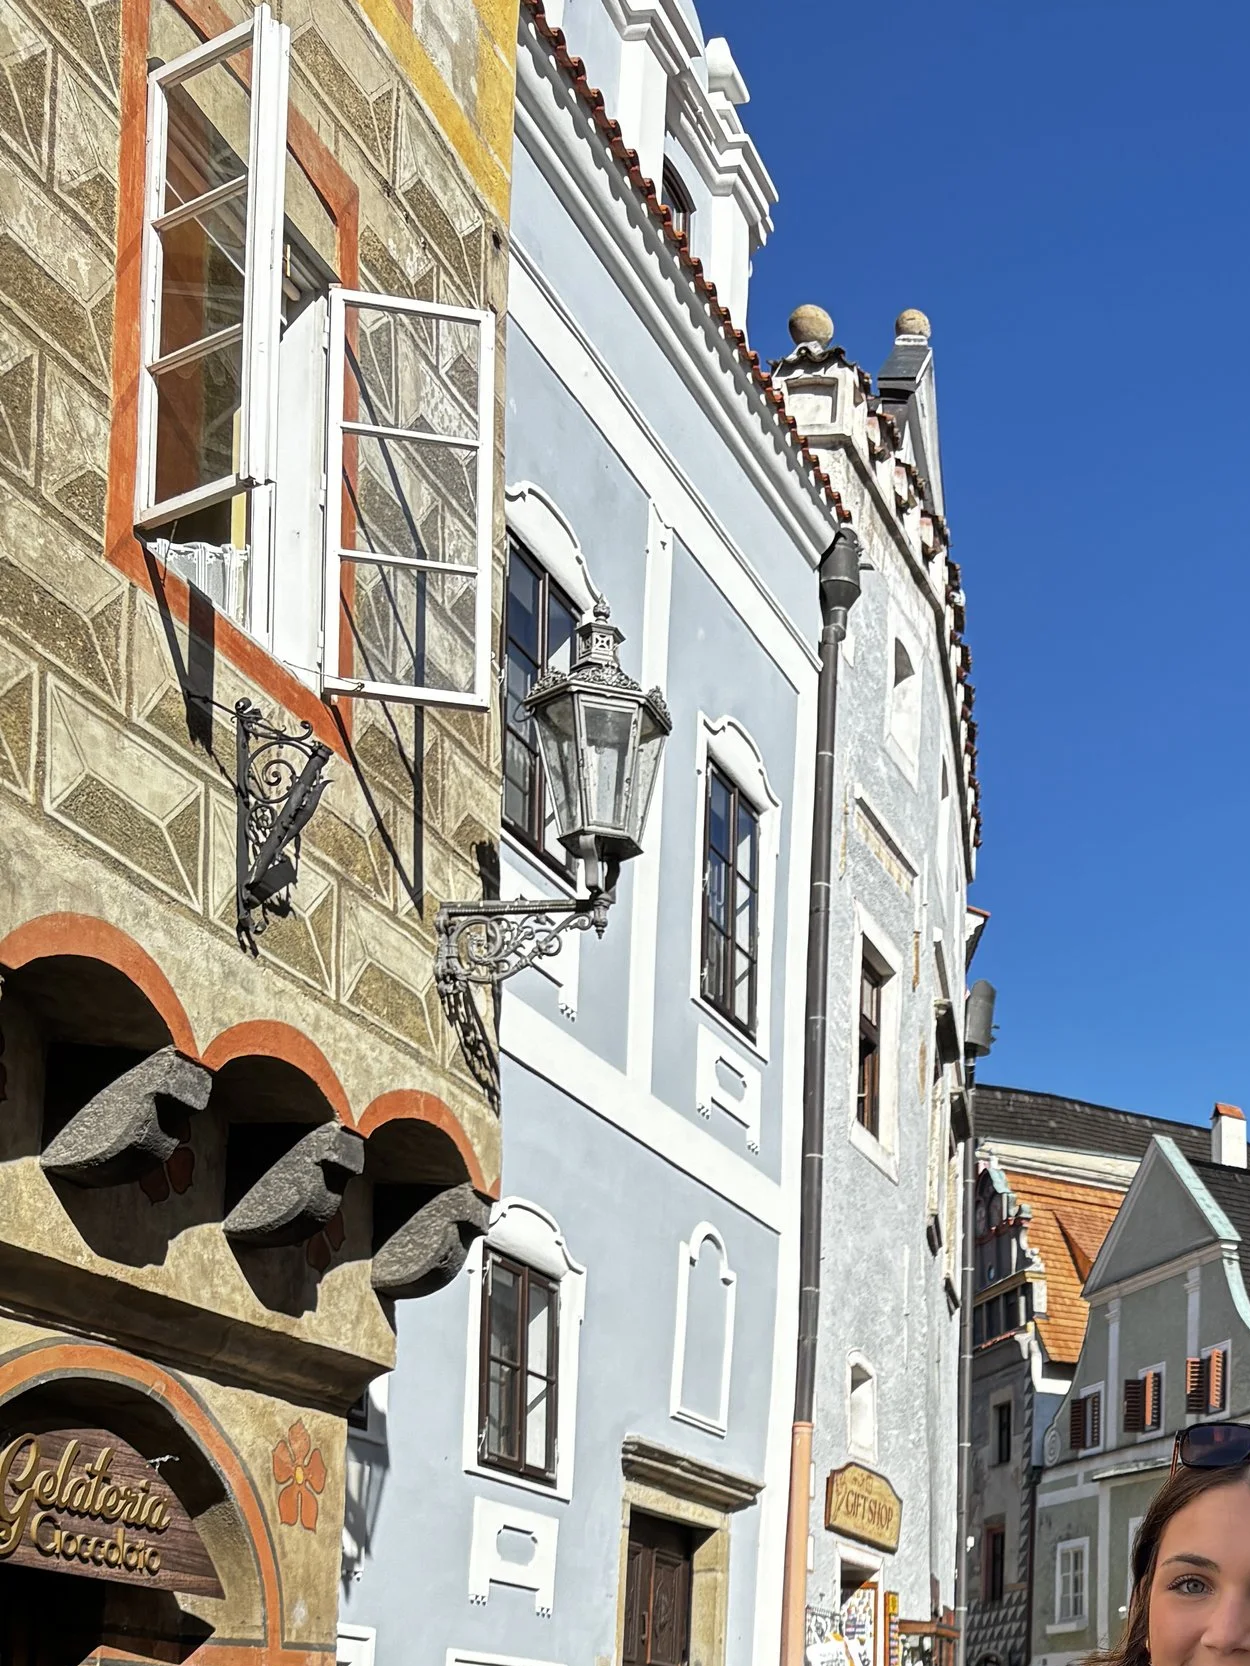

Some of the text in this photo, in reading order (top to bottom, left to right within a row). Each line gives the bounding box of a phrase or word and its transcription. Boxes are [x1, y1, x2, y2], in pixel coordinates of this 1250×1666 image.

[0, 1433, 172, 1553] Gelateria
[846, 1489, 894, 1531] GIFT SHOP
[30, 1511, 162, 1572] Cioccolato
